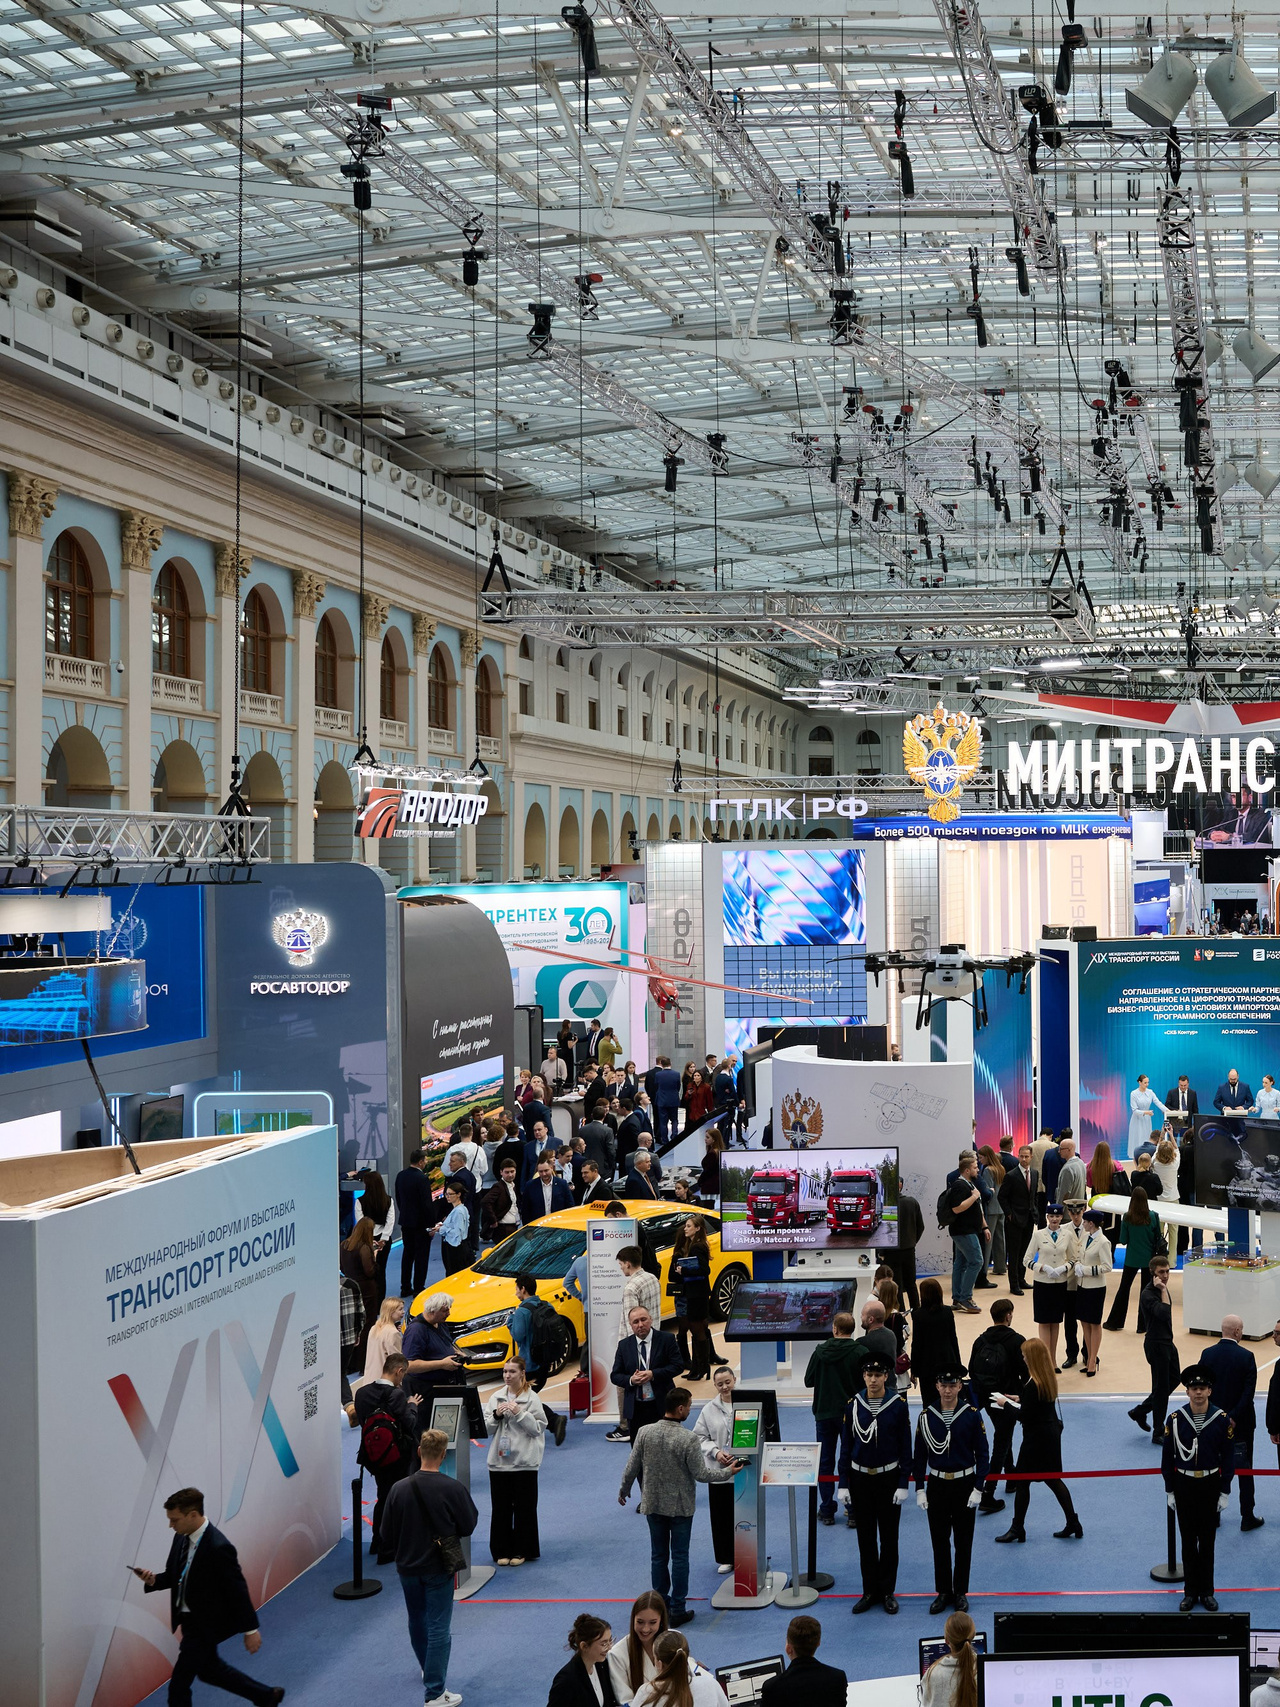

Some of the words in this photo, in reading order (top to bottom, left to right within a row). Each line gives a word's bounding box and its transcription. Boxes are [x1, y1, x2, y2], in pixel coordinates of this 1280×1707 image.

[1008, 737, 1275, 795] МИНТРАНС
[400, 790, 488, 828] АВТОДОР
[710, 798, 797, 820] ГТЛК
[812, 797, 869, 820] РФ
[875, 827, 904, 837] Более
[907, 826, 930, 836] 500
[933, 827, 978, 837] тысяч
[982, 826, 1037, 836] поездок
[1041, 826, 1057, 836] по
[1061, 824, 1088, 836] МЦК
[564, 906, 612, 943] 30
[589, 919, 605, 928] ЛЕТ
[759, 968, 779, 979] Вы
[783, 969, 832, 979] готовы
[250, 981, 350, 995] РОСАВТОДОР
[1181, 987, 1249, 995] СТРАТЕГИЧЕСКОМ
[1119, 996, 1178, 1004] НАПРАВЛЕННОЕ
[1191, 995, 1236, 1003] ЦИФРОВУЮ
[1107, 1004, 1184, 1013] БИЗНЕС-ПРОЦЕССОВ
[1191, 1004, 1232, 1012] УСЛОВИЯХ
[1153, 1012, 1215, 1020] ПРОГРАММНОГО
[1217, 1012, 1271, 1020] ОБЕСПЕЧЕНИЯ
[777, 1227, 812, 1236] проекта:
[105, 1230, 205, 1283] МЕЖДУНАРОДНЫЙ
[207, 1219, 242, 1244] ФОРУМ
[243, 1216, 250, 1231] И
[251, 1199, 296, 1228] ВЫСТАВКА
[764, 1236, 793, 1244] Natcar,
[106, 1250, 225, 1322] ТРАНСПОРТ
[229, 1222, 295, 1273] РОССИИ
[107, 1320, 149, 1347] TRANSPORT
[150, 1315, 159, 1328] OF
[160, 1306, 184, 1324] RUSSIA
[187, 1285, 233, 1312] INTERNATIONAL
[234, 1276, 254, 1291] FORUM
[255, 1271, 267, 1282] AND
[267, 1256, 296, 1277] EXHIBITION
